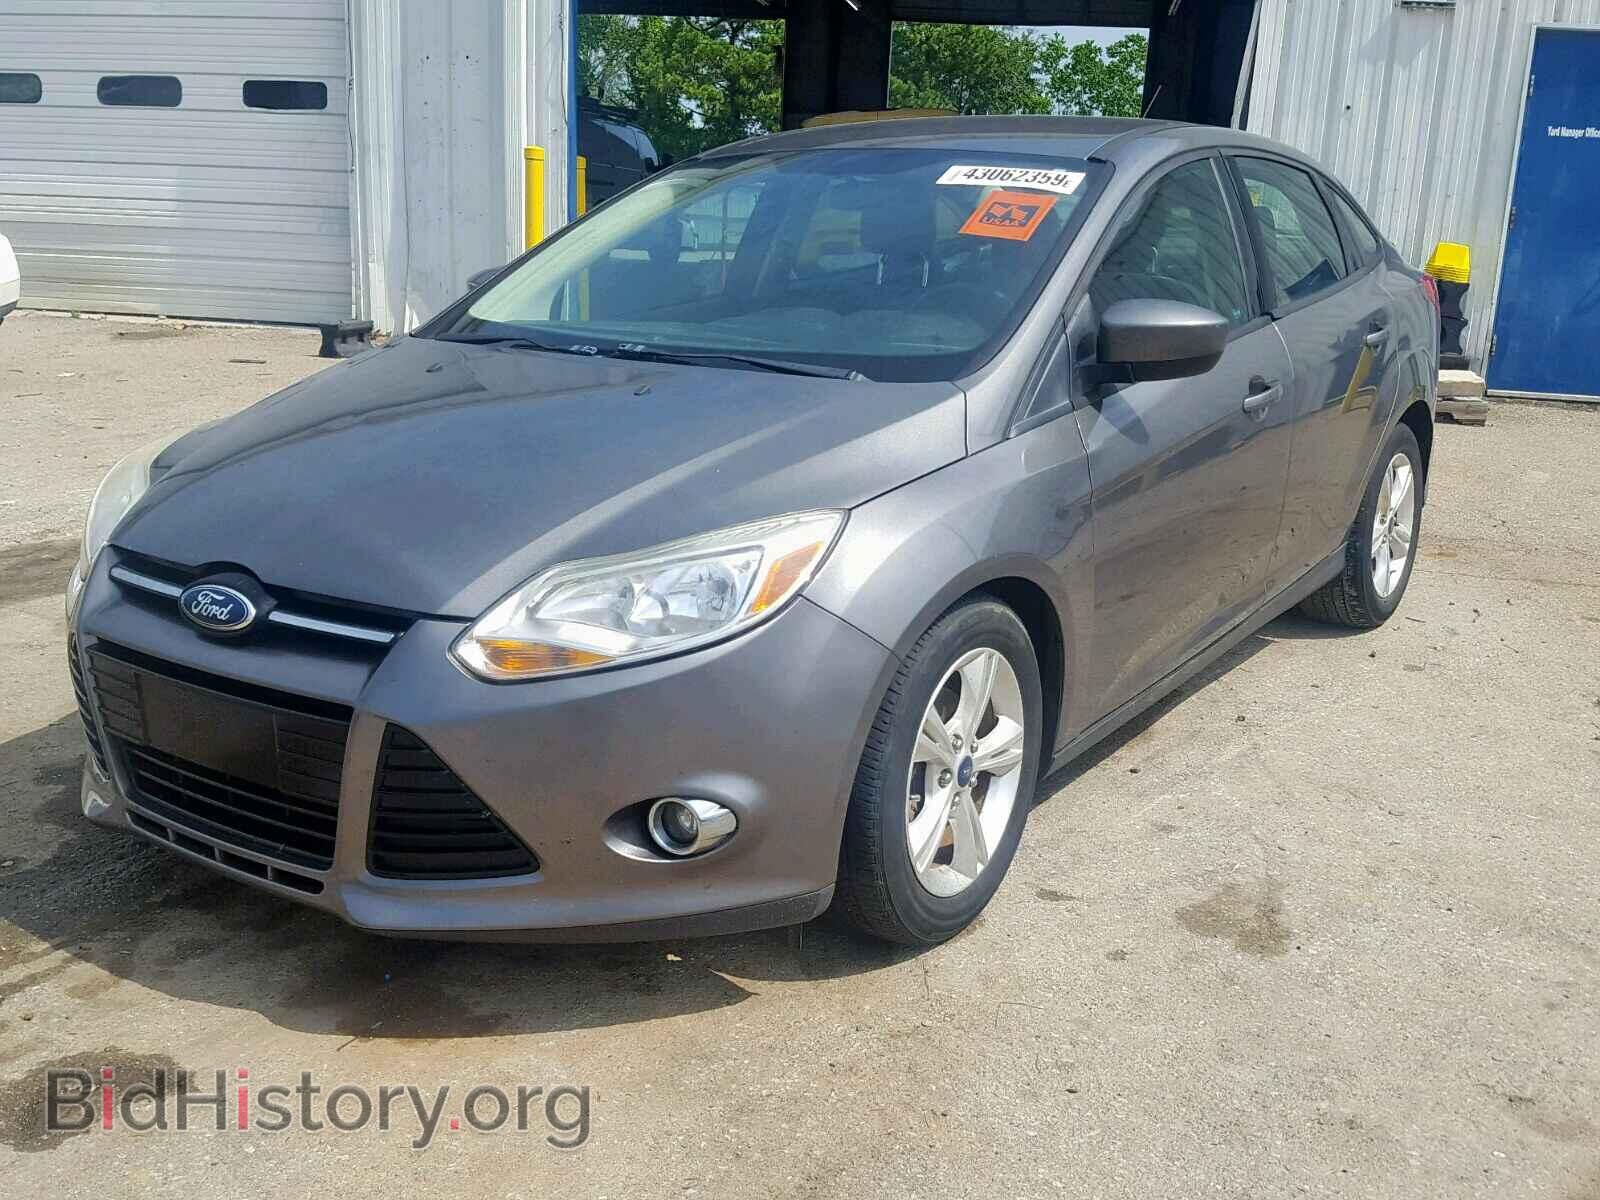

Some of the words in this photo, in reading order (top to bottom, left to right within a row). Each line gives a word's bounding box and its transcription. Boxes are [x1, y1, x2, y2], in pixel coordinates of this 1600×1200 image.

[1561, 126, 1585, 139] Manager
[963, 167, 1068, 187] 43062359
[191, 590, 234, 621] Ford
